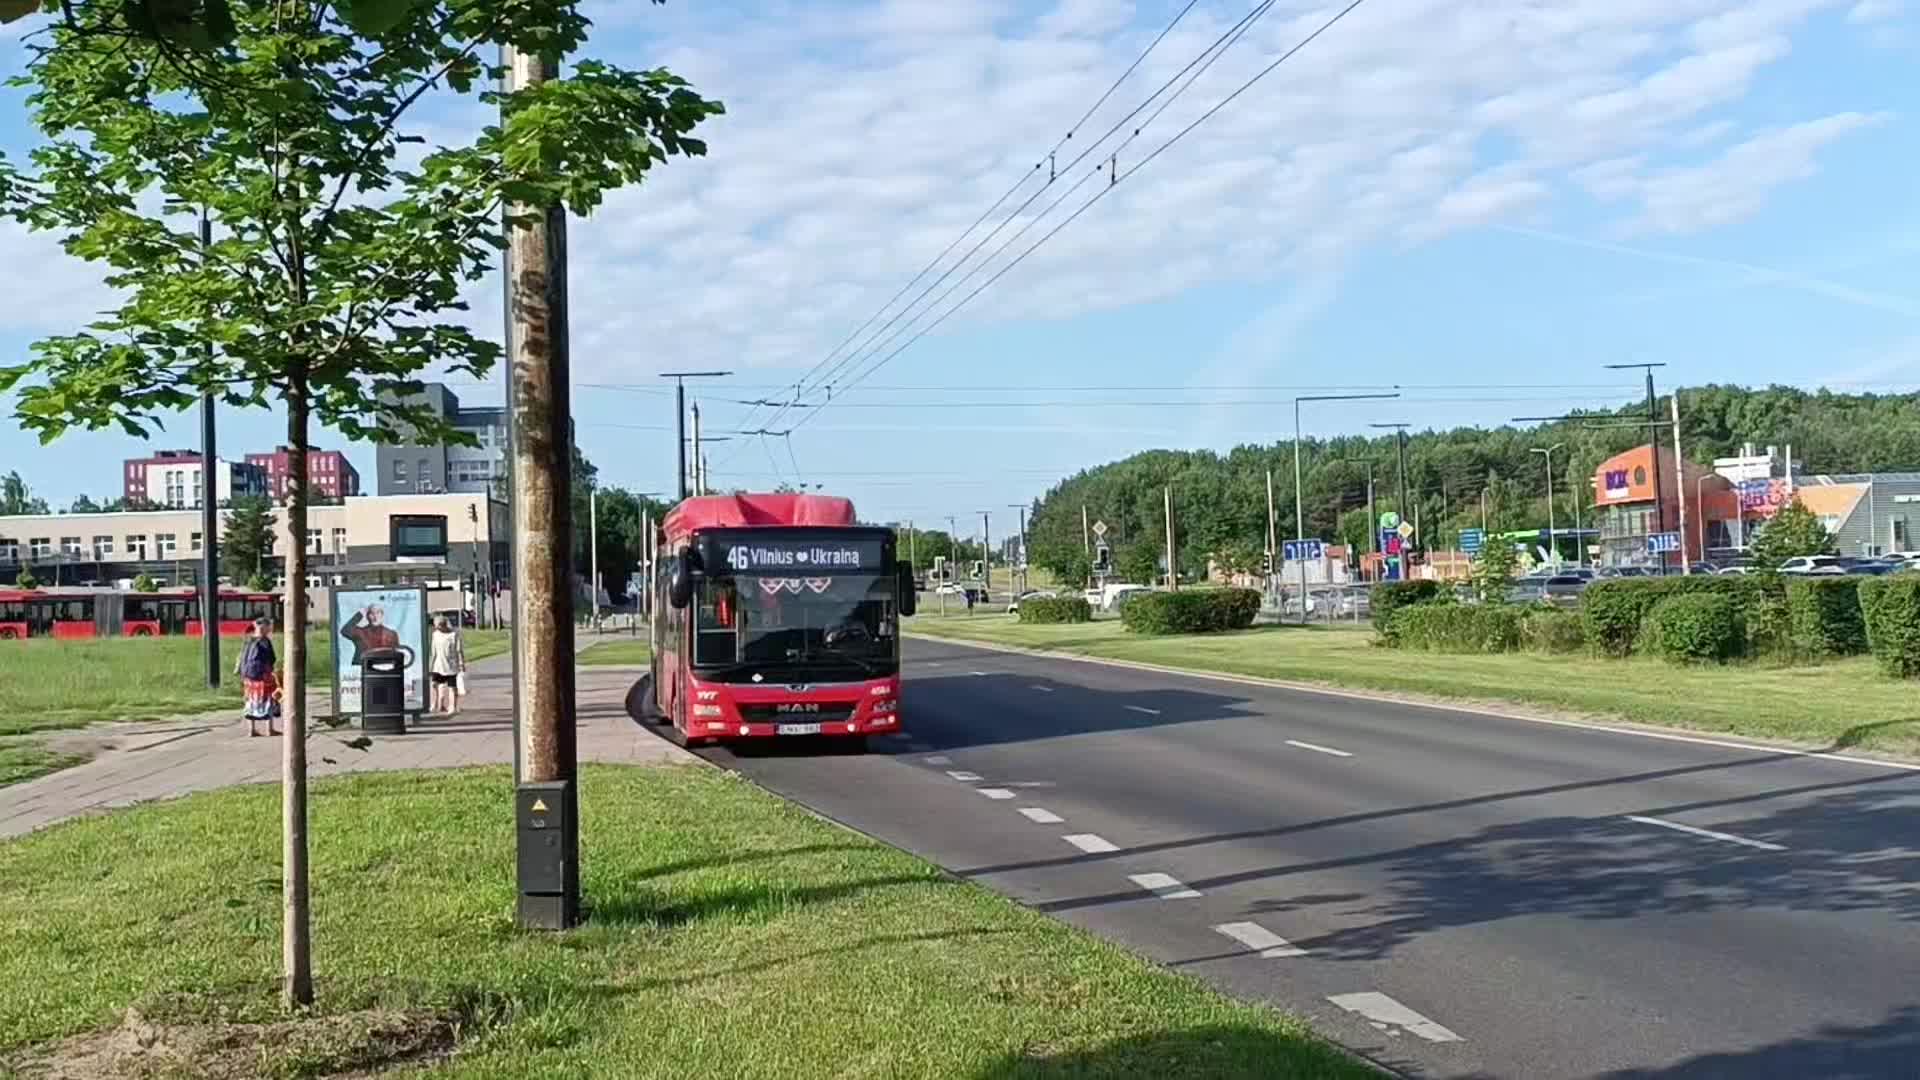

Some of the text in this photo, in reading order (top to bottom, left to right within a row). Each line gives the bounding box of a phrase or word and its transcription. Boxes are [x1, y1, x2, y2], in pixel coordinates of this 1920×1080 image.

[727, 545, 748, 569] 46
[750, 548, 793, 565] Vilnius
[777, 703, 819, 712] MAN
